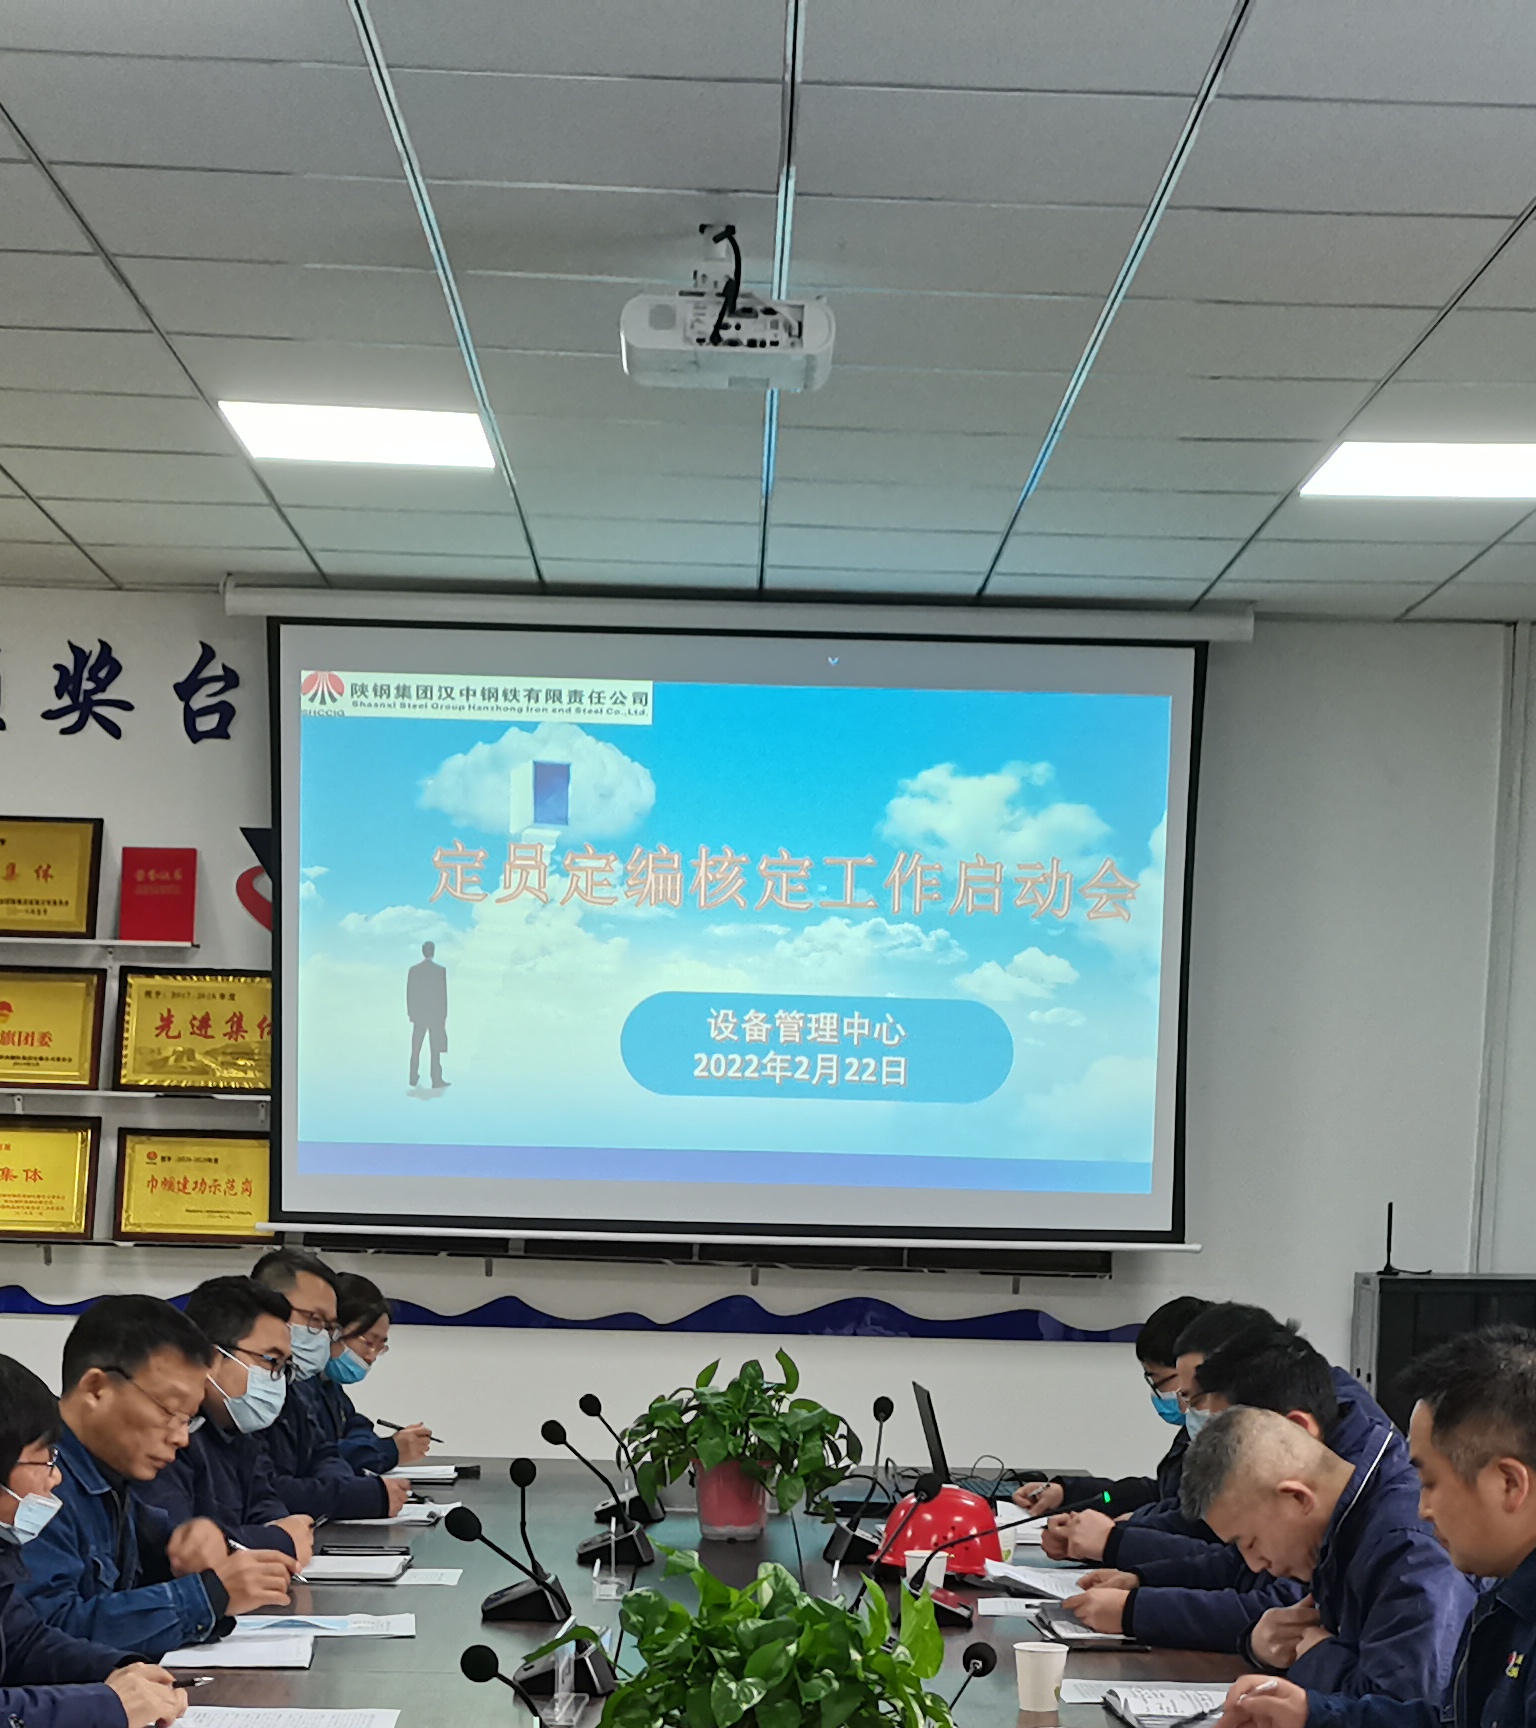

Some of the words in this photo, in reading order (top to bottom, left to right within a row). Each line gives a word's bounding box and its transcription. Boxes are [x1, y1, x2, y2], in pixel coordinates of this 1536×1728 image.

[350, 681, 650, 707] 陕钢集团汉中钢铁有限责任公司
[427, 839, 1141, 924] 定员定编核定工作启动会
[706, 1007, 906, 1047] 设备管理中心
[691, 1049, 909, 1088] 2022年2月22日
[146, 1174, 253, 1198] 巾帼建功示范岗
